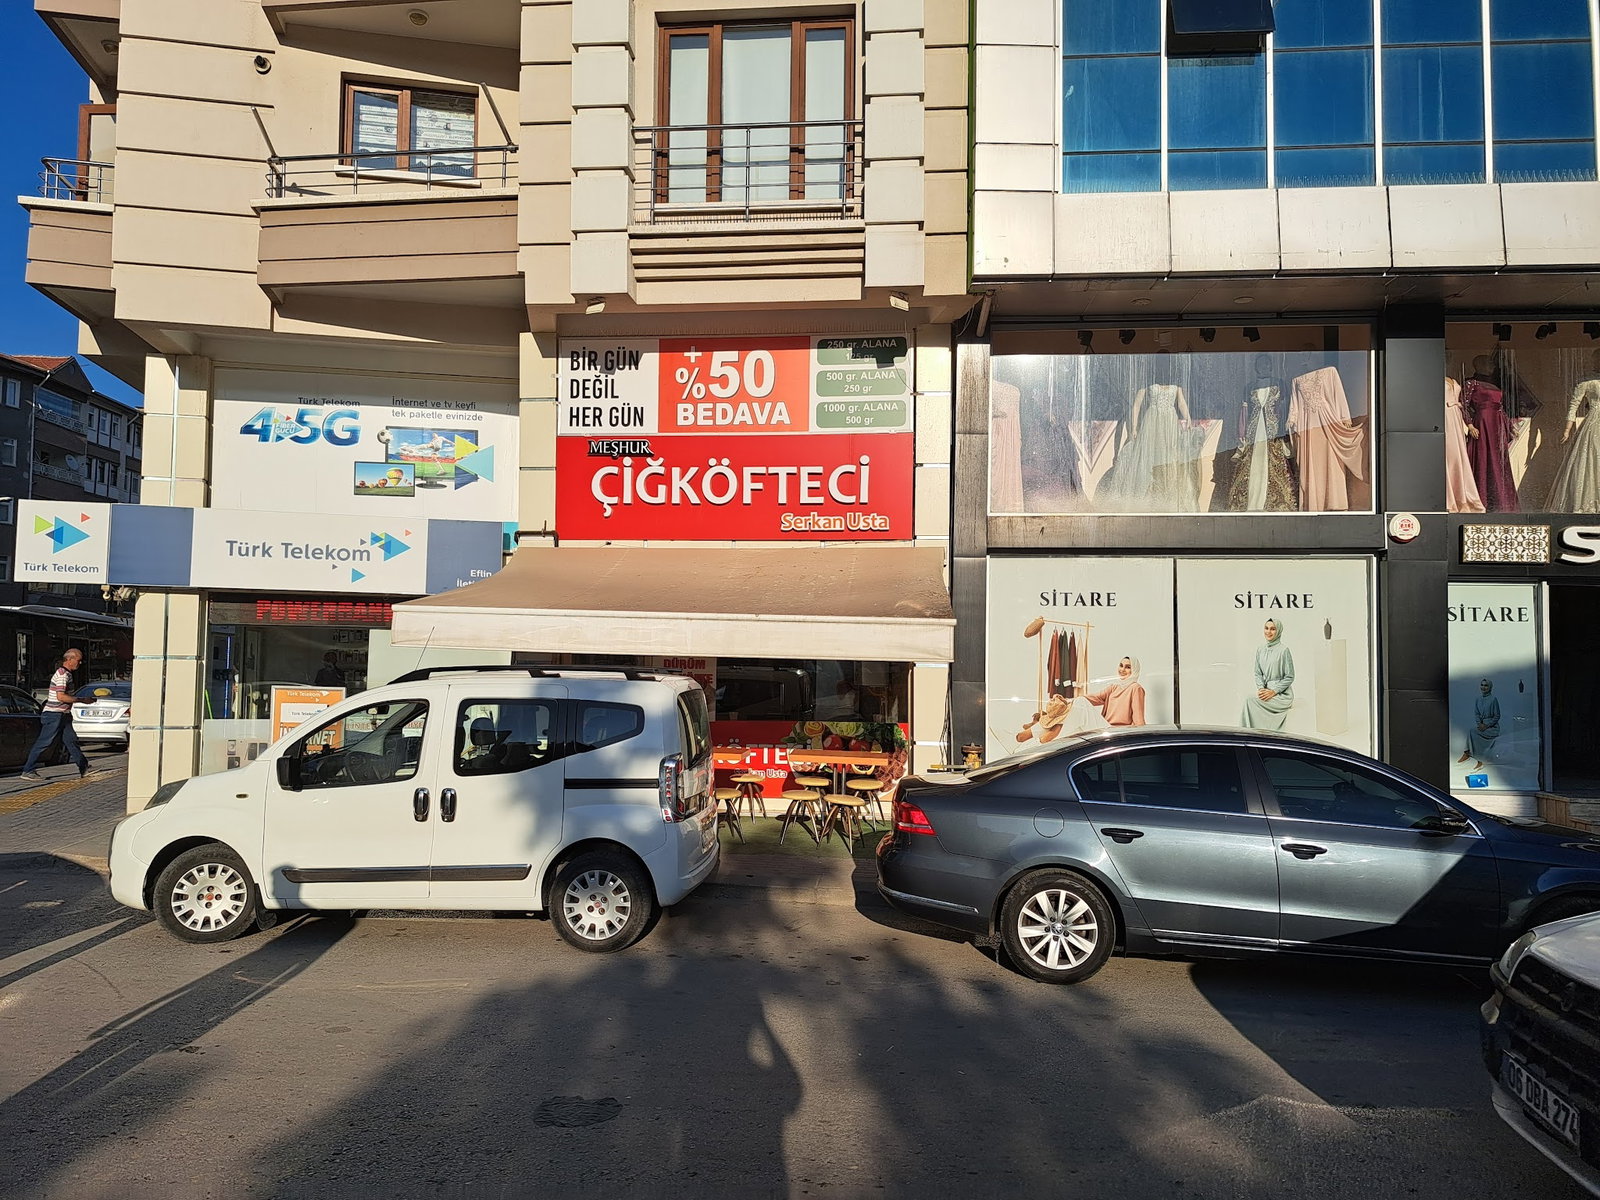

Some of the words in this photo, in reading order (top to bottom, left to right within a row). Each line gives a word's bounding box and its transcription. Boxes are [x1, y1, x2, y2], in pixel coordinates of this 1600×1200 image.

[827, 341, 844, 350] 250
[861, 339, 897, 348] ALANA
[570, 346, 599, 371] BİR
[603, 346, 640, 372] GÜN
[826, 372, 843, 381] 500
[860, 371, 896, 380] ALANA
[569, 374, 620, 399] DEĞİL
[844, 385, 860, 393] 250
[862, 386, 873, 394] gr
[298, 396, 319, 406] Türk
[321, 398, 361, 407] Telekom
[391, 395, 428, 407] İnternet
[444, 400, 452, 409] tv
[455, 401, 476, 411] keyfi
[823, 403, 846, 412] 1000
[862, 402, 898, 411] ALANA
[391, 409, 406, 418] tek
[409, 410, 443, 420] paketle
[445, 412, 484, 421] evinizde
[569, 407, 604, 428] HER
[608, 404, 645, 428] GÜN
[676, 402, 791, 427] BEDAVA
[845, 416, 861, 424] 500
[863, 417, 874, 425] gr
[589, 440, 652, 457] MEŞHUR
[590, 455, 871, 518] ÇİĞKÖFTECİ
[780, 512, 845, 531] Serkan
[846, 511, 890, 530] Usta
[225, 540, 273, 559] Türk
[281, 541, 372, 563] Telekom
[24, 562, 48, 573] Türk
[52, 563, 99, 574] Telekom
[1040, 588, 1118, 607] SİTARE
[1234, 590, 1315, 610] SİTARE
[1448, 603, 1529, 623] SİTARE
[766, 769, 788, 778] Usta
[1508, 1061, 1523, 1094] 06
[1525, 1074, 1550, 1119] DBA
